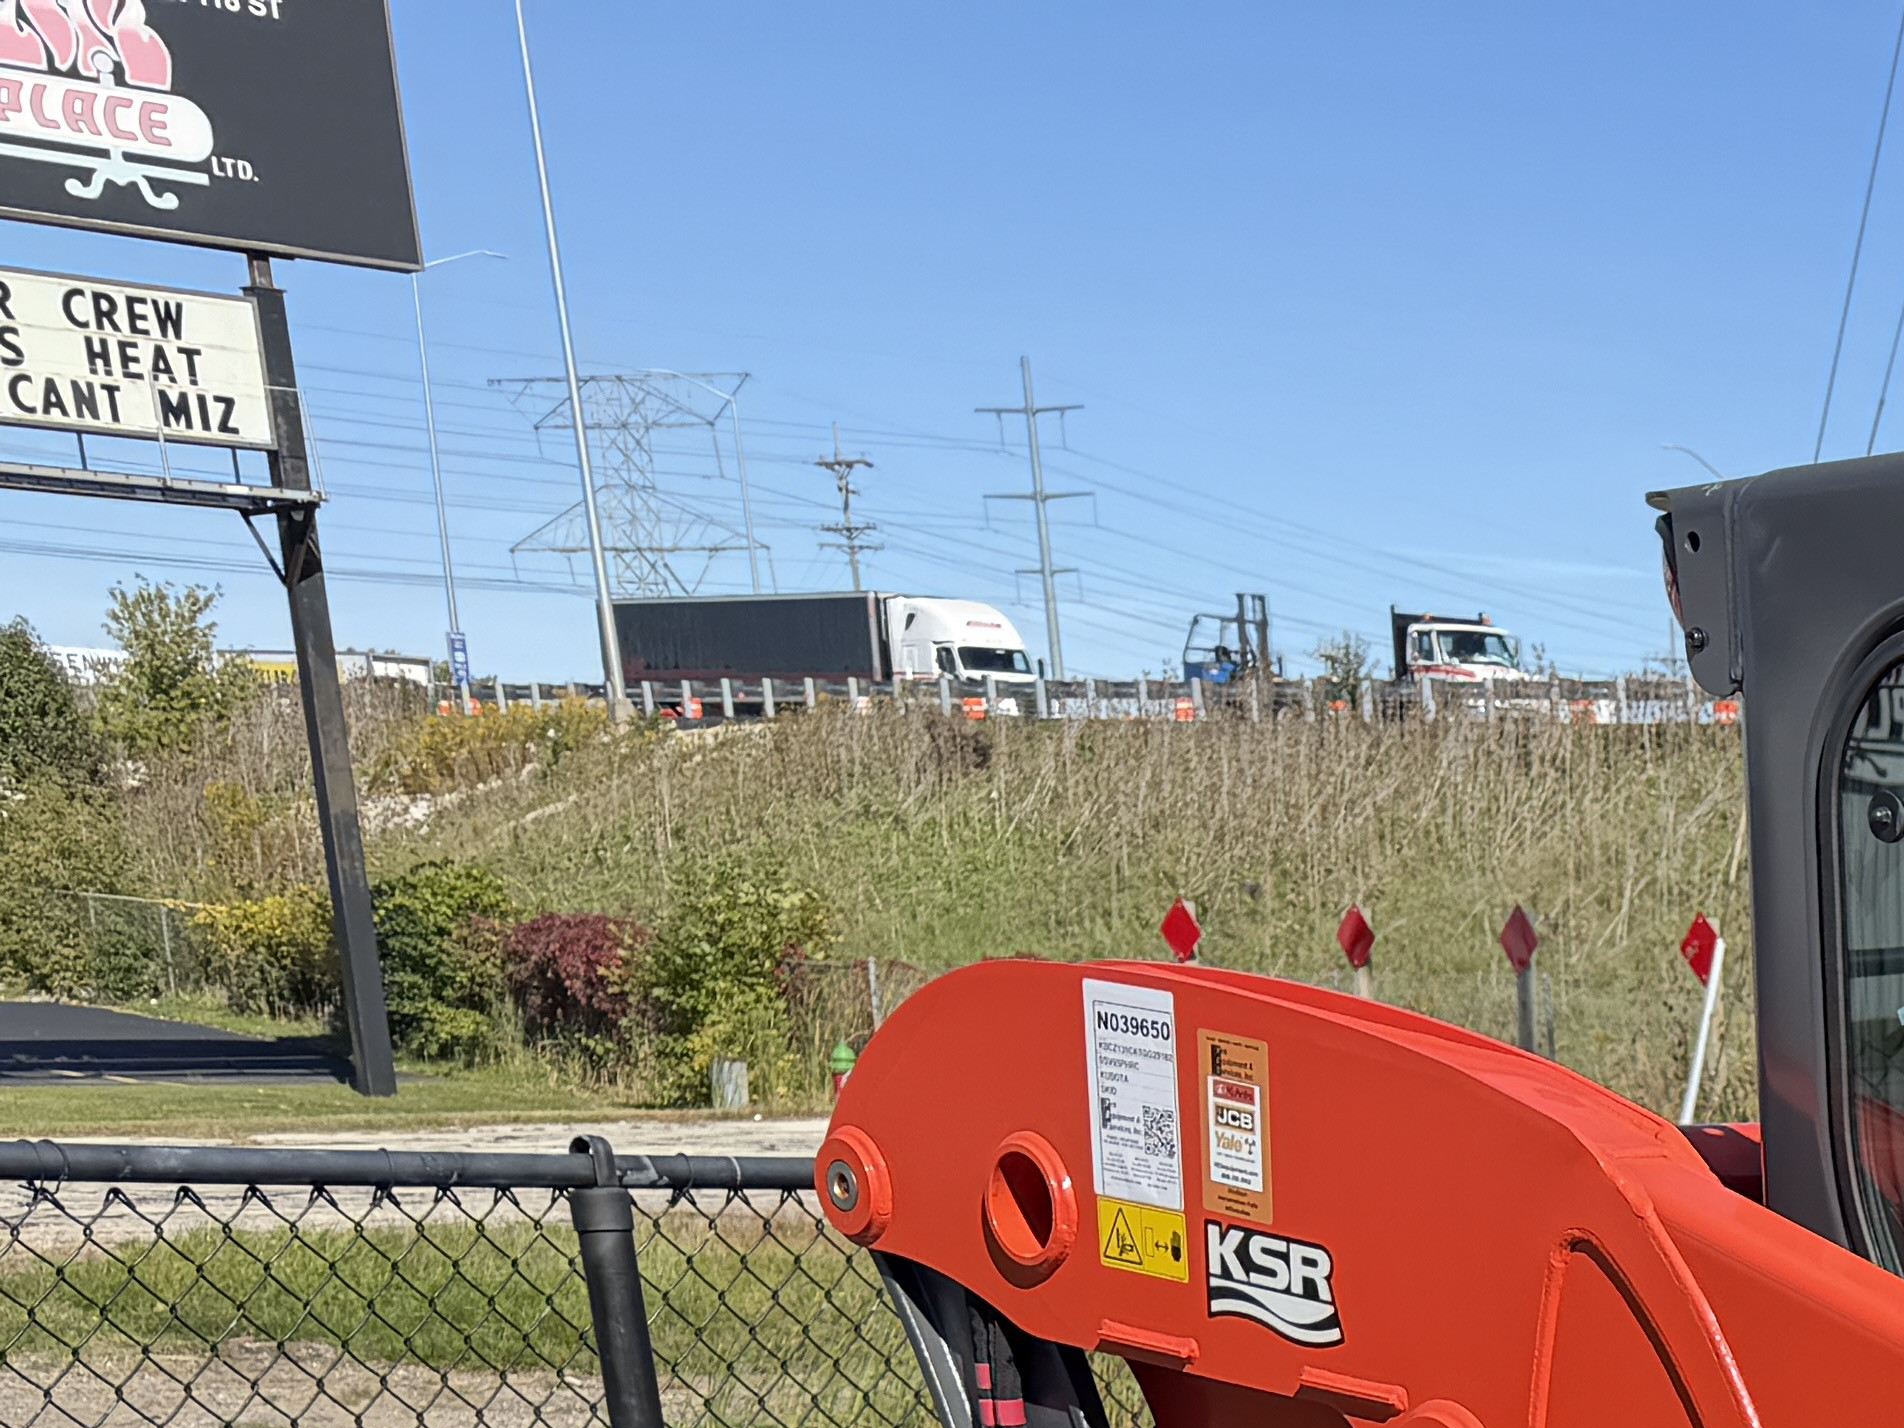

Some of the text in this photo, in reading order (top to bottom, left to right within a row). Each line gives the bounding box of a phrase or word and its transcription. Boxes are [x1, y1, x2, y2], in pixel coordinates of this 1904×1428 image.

[211, 154, 260, 182] LTD.
[61, 287, 184, 341] CREW
[84, 335, 202, 387] HEAT
[8, 372, 240, 435] CANT MIZ
[1097, 1010, 1171, 1042] N039650
[1216, 1107, 1254, 1130] JCB
[1207, 1223, 1333, 1302] KSR
